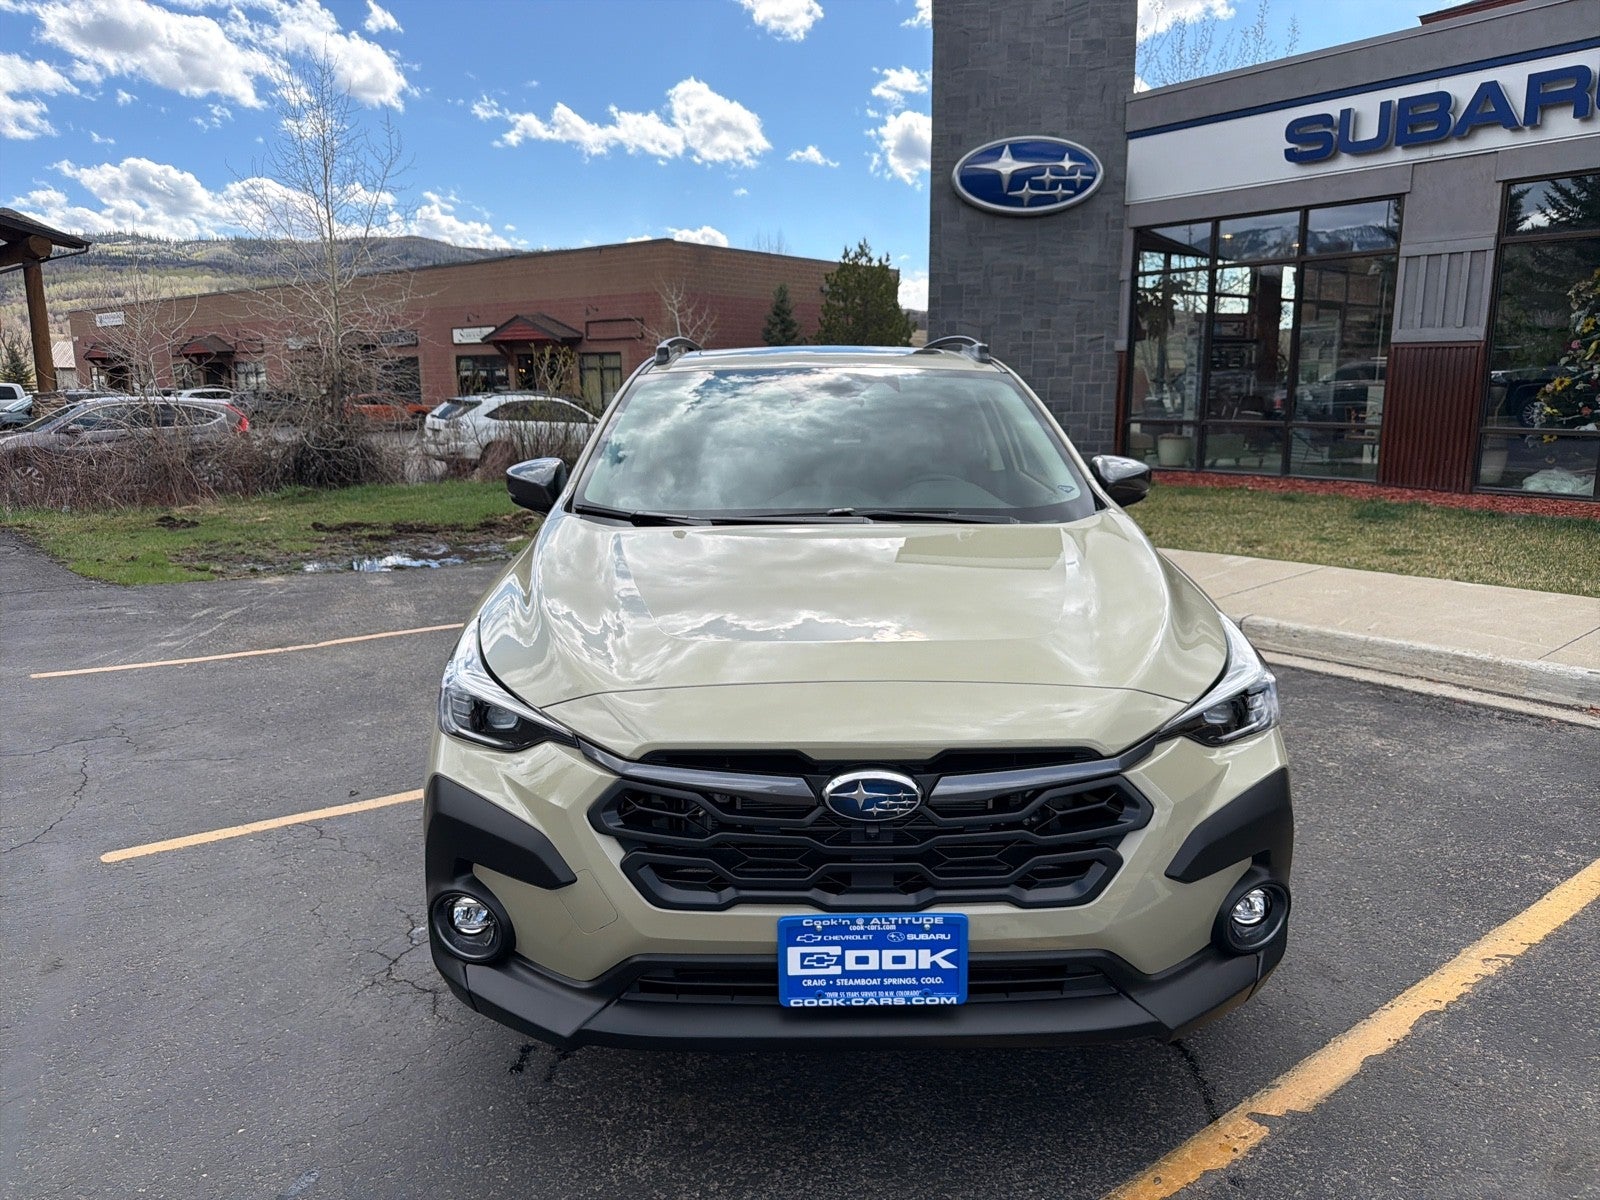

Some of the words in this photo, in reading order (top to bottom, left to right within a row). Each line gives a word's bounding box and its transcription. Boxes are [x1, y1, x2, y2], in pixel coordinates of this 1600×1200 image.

[1284, 64, 1600, 164] SUBAR
[802, 918, 850, 926] Cook'n
[870, 917, 944, 925] ALTITUDE
[787, 946, 958, 976] COOK
[802, 979, 827, 987] CRAIG
[836, 978, 881, 986] STEAMBOAT
[883, 977, 919, 985] SPRINGS,
[920, 976, 944, 984] COLO.
[790, 997, 957, 1007] COOK-CARS.COM
